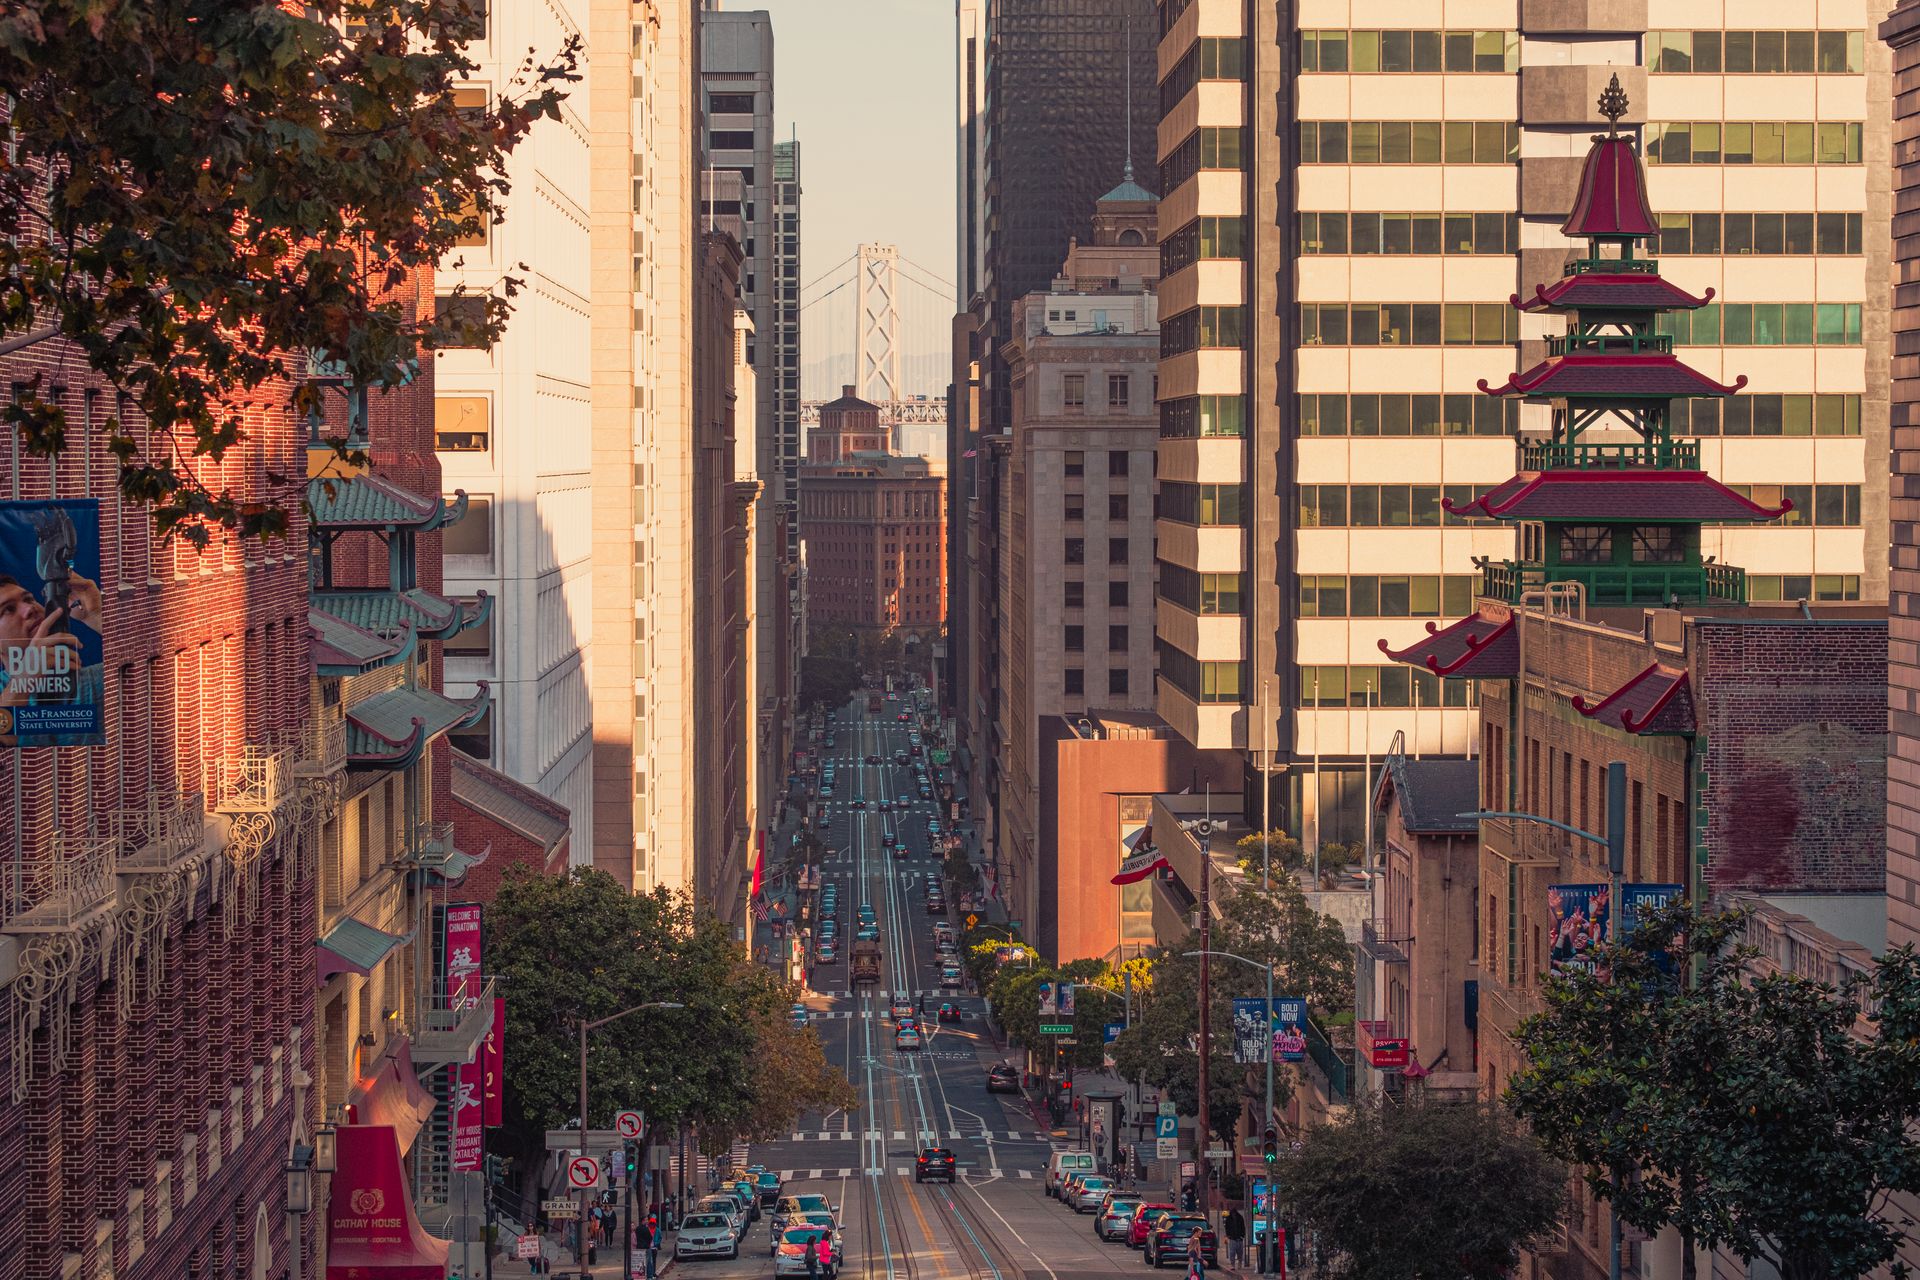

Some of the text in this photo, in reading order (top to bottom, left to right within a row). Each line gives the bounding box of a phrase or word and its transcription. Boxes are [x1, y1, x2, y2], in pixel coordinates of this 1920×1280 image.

[8, 645, 70, 676] BOLD
[10, 677, 71, 693] ANSWERS
[448, 910, 480, 921] WELCOME TO
[449, 922, 478, 933] CHINATOWN
[1281, 1003, 1298, 1012] BOLD
[1281, 1013, 1298, 1021] NOW
[1242, 1040, 1259, 1048] BOLD
[334, 1219, 401, 1228] CATHAY HOUSE
